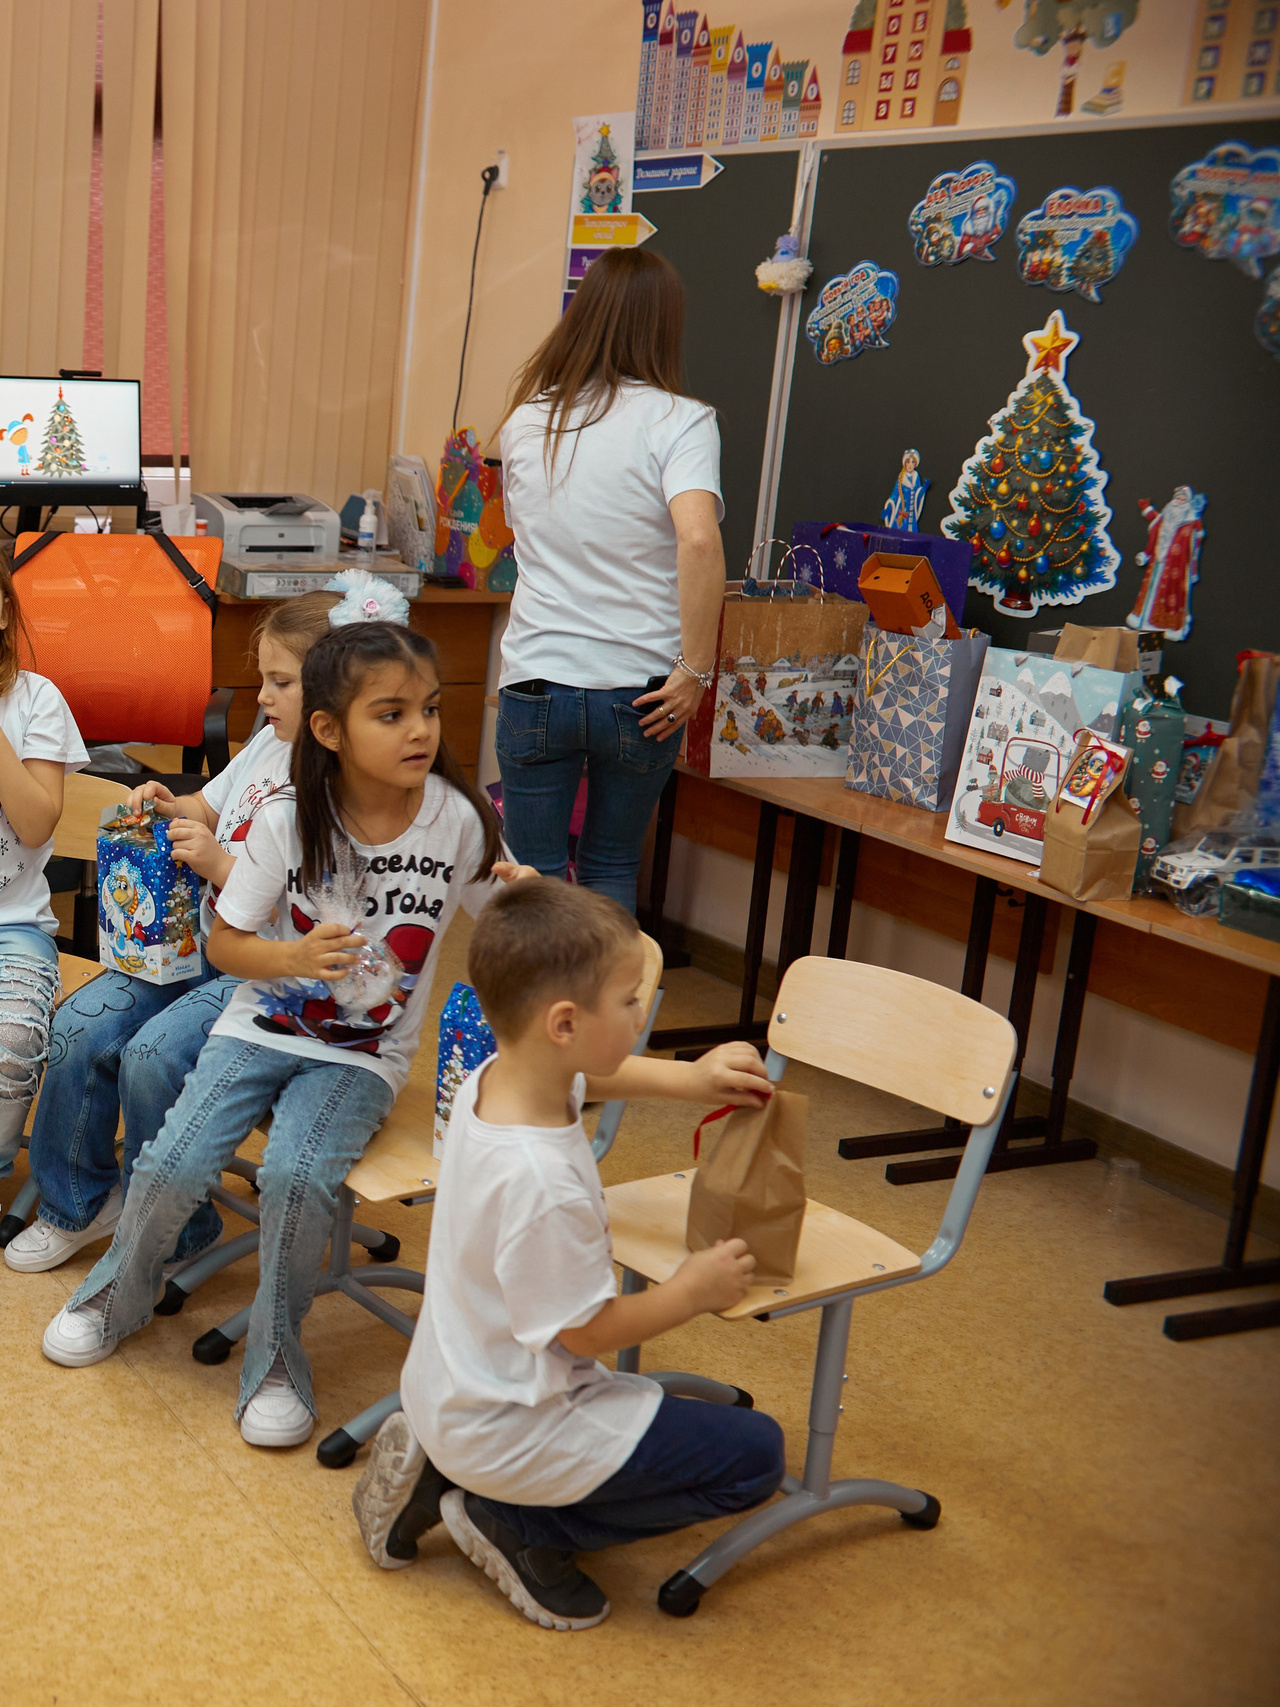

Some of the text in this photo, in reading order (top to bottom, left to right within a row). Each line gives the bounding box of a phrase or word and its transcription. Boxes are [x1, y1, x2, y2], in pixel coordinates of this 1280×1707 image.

[635, 166, 698, 181] Домашнее задание
[850, 269, 867, 287] ГОД
[440, 516, 479, 534] РОЖДЕНИЯ!
[365, 854, 454, 884] селого
[385, 887, 444, 920] Года
